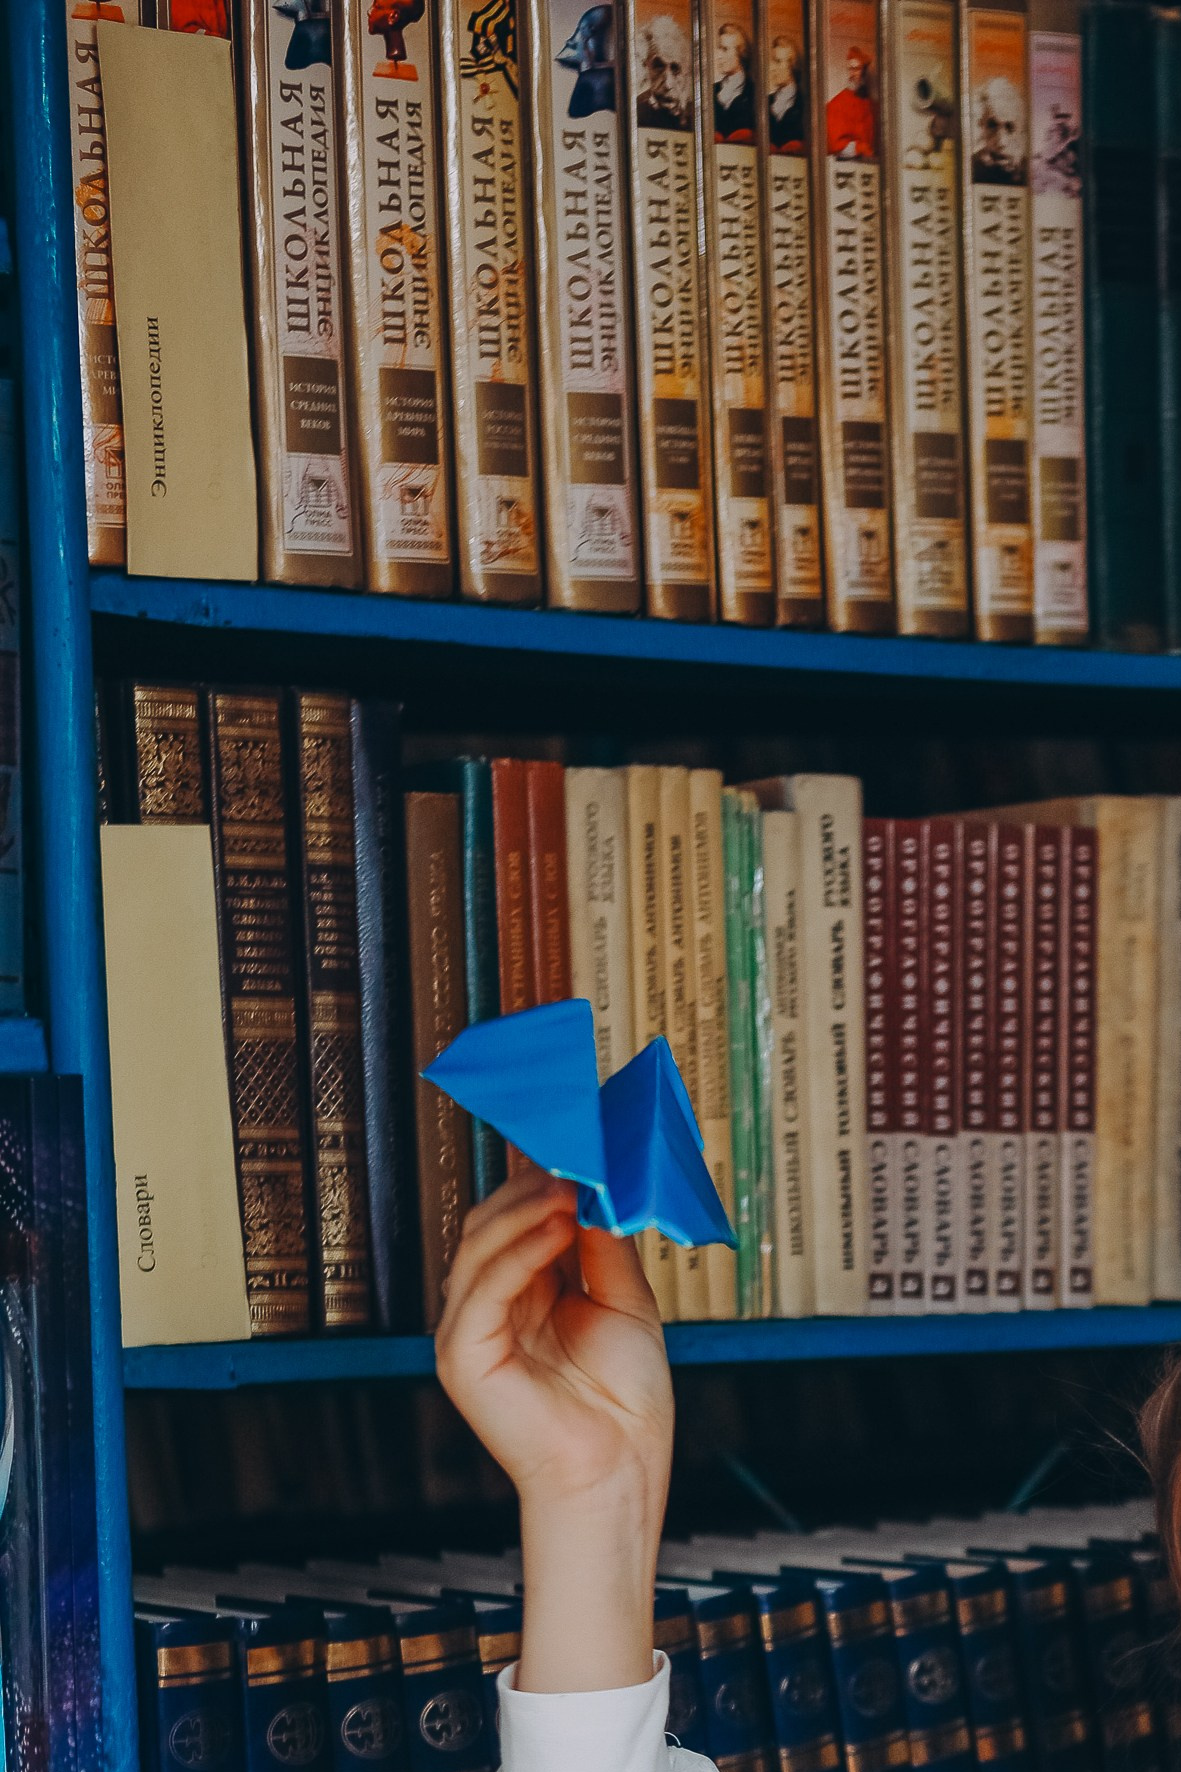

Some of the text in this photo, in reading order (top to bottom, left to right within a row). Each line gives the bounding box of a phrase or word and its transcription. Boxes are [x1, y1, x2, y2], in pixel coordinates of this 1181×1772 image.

[75, 40, 112, 300] ШКОЛЬНАЯ
[279, 80, 311, 335] ШКОЛЬНАЯ
[309, 83, 335, 339] ЭНЦИКЛОПЕДИЯ
[375, 96, 407, 346] ШКОЛЬНАЯ
[405, 101, 433, 350] ЭНЦИКЛОПЕДИЯ
[471, 115, 501, 360] ШКОЛЬНАЯ
[499, 119, 523, 365] ЭНЦИКЛОПЕДИЯ
[562, 128, 593, 371] ШКОЛЬНАЯ
[592, 131, 621, 374] ЭНЦИКЛОПЕДИЯ
[646, 138, 675, 376] ШКОЛЬНАЯ
[718, 163, 745, 375] ШКОЛЬНАЯ
[773, 175, 796, 384] ШКОЛЬНАЯ
[834, 170, 861, 400] ШКОЛЬНАЯ
[146, 315, 168, 498] Энциклопедии
[289, 382, 337, 395] ИСТОРИЯ
[909, 185, 937, 411] ШКОЛЬНАЯ
[979, 194, 1007, 418] ШКОЛЬНАЯ
[1038, 226, 1062, 425] ШКОЛЬНАЯ
[584, 801, 600, 903] РУССКОГО
[594, 917, 611, 1012] СЛОВАРЬ
[821, 813, 836, 909] РУССКОГО
[836, 844, 852, 907] ЯЗЫКА
[781, 1030, 805, 1258] ШКОЛЬНЫЙ СЛОВАРЬ
[830, 919, 854, 1271] ШКОЛЬНЫЙ ТОЛКОВЫЙ СЛОВАРЬ
[867, 835, 889, 1265] ОРФОГРАФИЧЕСКИЙ СЛОВАРЬ
[901, 837, 921, 1265] ОРФОГРАФИЧЕСКИЙ СЛОВАРЬ
[934, 843, 952, 1267] ОРФОГРАФИЧЕСКИЙ СЛОВАРЬ
[968, 839, 986, 1261] ОРФОГРАФИЧЕСКИЙ СЛОВАРЬ
[1001, 843, 1020, 1262] ОРФОГРАФИЧЕСКИЙ СЛОВАРЬ
[1036, 843, 1055, 1261] ОРФОГРАФИЧЕСКИЙ СЛОВАРЬ
[1072, 844, 1091, 1260] ОРФОГРАФИЧЕСКИЙ СЛОВАРЬ
[134, 1174, 157, 1273] Словари
